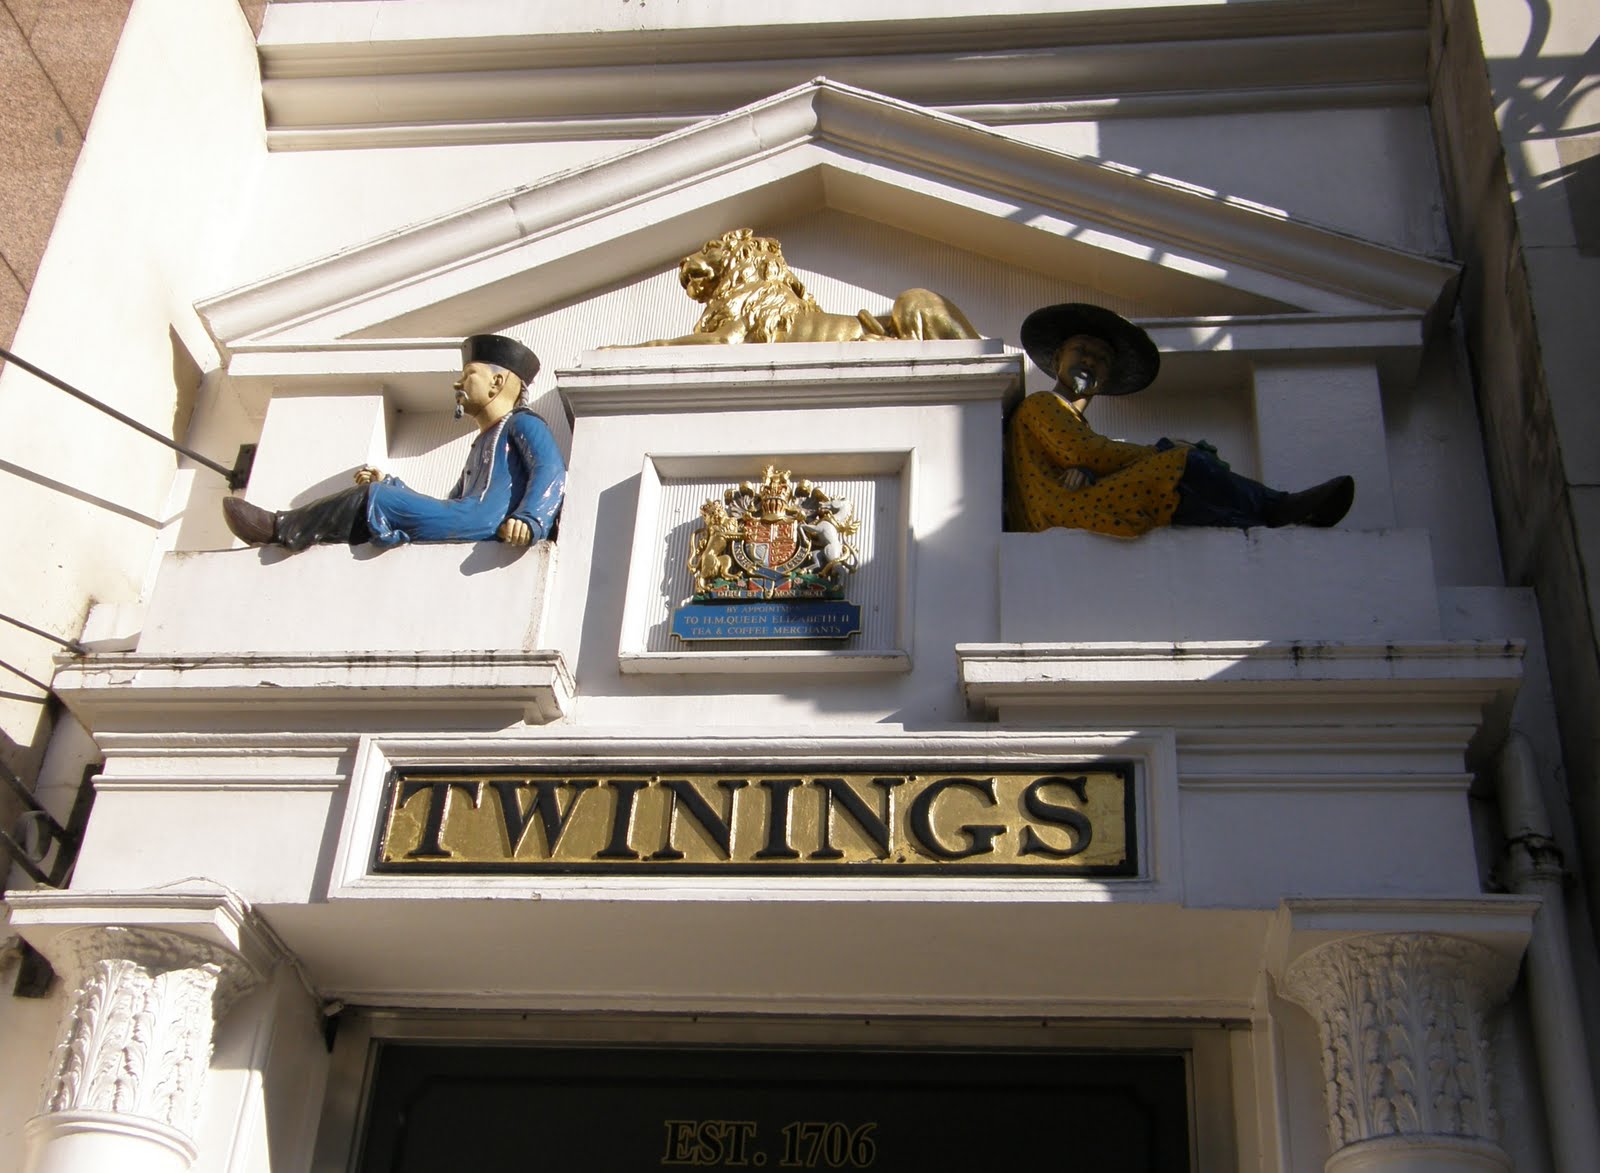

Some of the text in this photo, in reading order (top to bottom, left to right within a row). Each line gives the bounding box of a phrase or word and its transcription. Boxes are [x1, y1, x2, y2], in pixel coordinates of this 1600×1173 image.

[726, 605, 802, 614] BY APPOINTM
[684, 615, 698, 625] TO
[772, 614, 836, 625] ELIZABETH
[841, 614, 849, 623] II
[690, 625, 841, 636] TEA & COFFEE MERCHANTS
[398, 775, 1093, 861] TWININGS
[660, 1119, 878, 1168] EST. 1706
